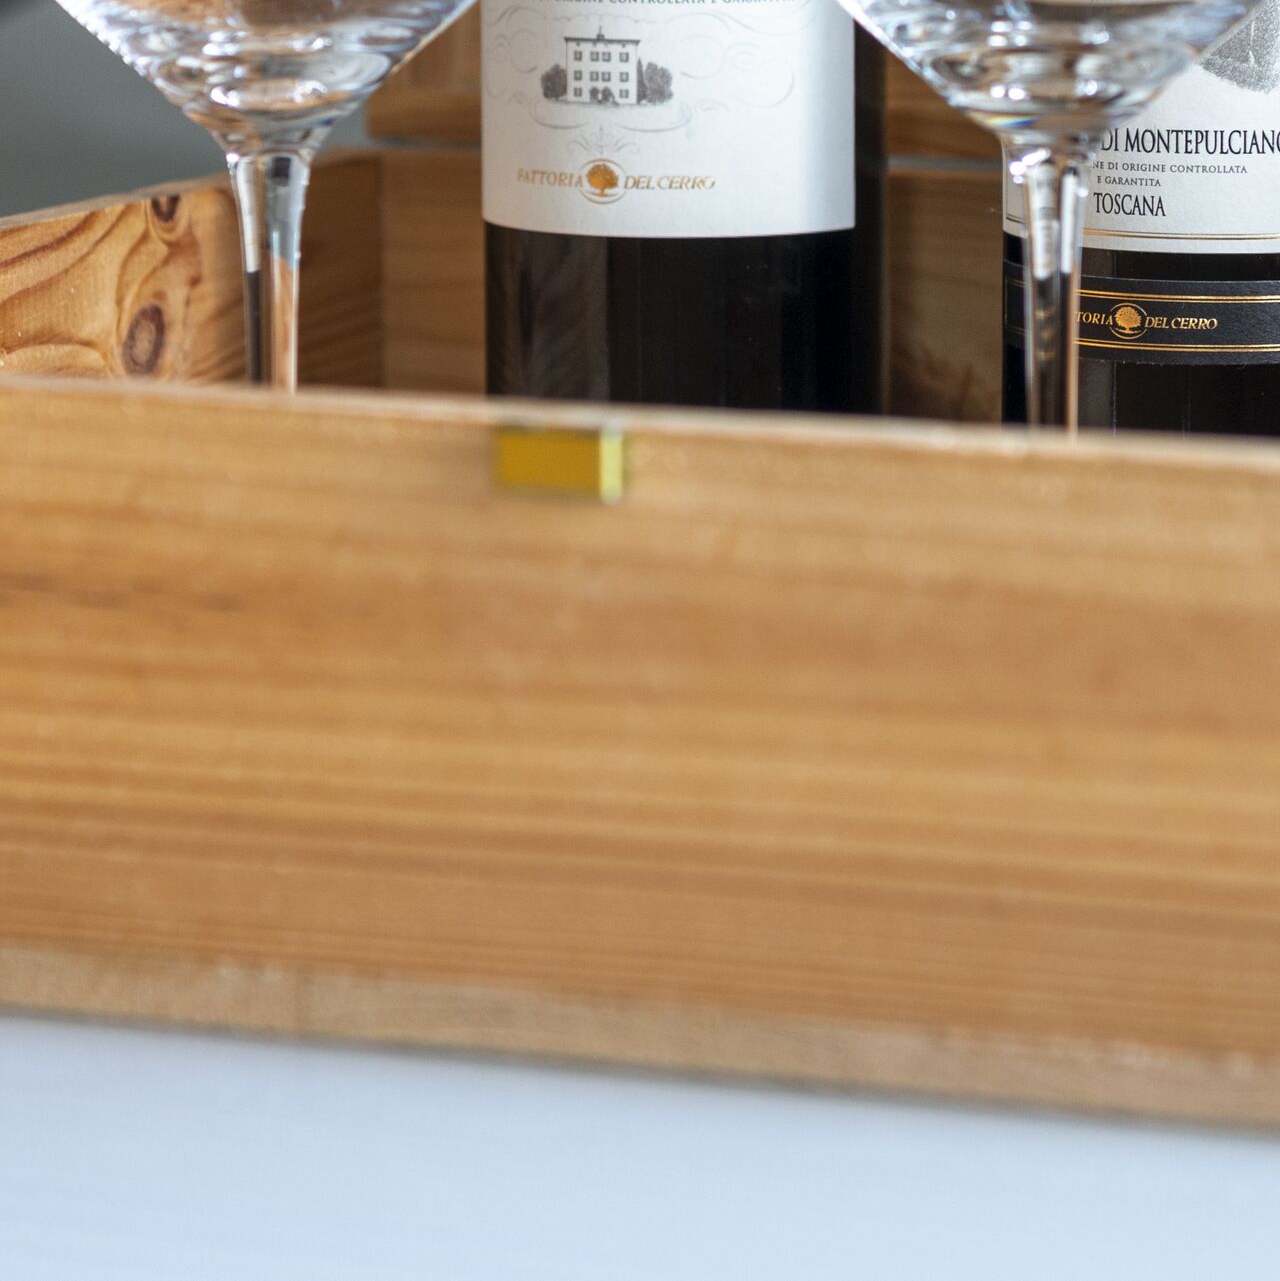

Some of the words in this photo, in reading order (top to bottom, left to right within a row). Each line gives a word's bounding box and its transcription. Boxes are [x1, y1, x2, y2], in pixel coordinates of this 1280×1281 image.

[1108, 162, 1119, 171] DI
[1122, 162, 1166, 173] ORIGINE
[1170, 164, 1248, 174] CONTROLLATA
[516, 167, 584, 189] FATTORIA
[624, 175, 655, 190] DEL
[657, 175, 716, 191] CERRO
[1097, 175, 1102, 184] E
[1105, 176, 1162, 187] GARANTITA
[1093, 192, 1167, 217] TOSCANA
[1076, 311, 1114, 325] TORIA
[1144, 316, 1170, 329] DEL
[1171, 317, 1218, 330] CERRO
